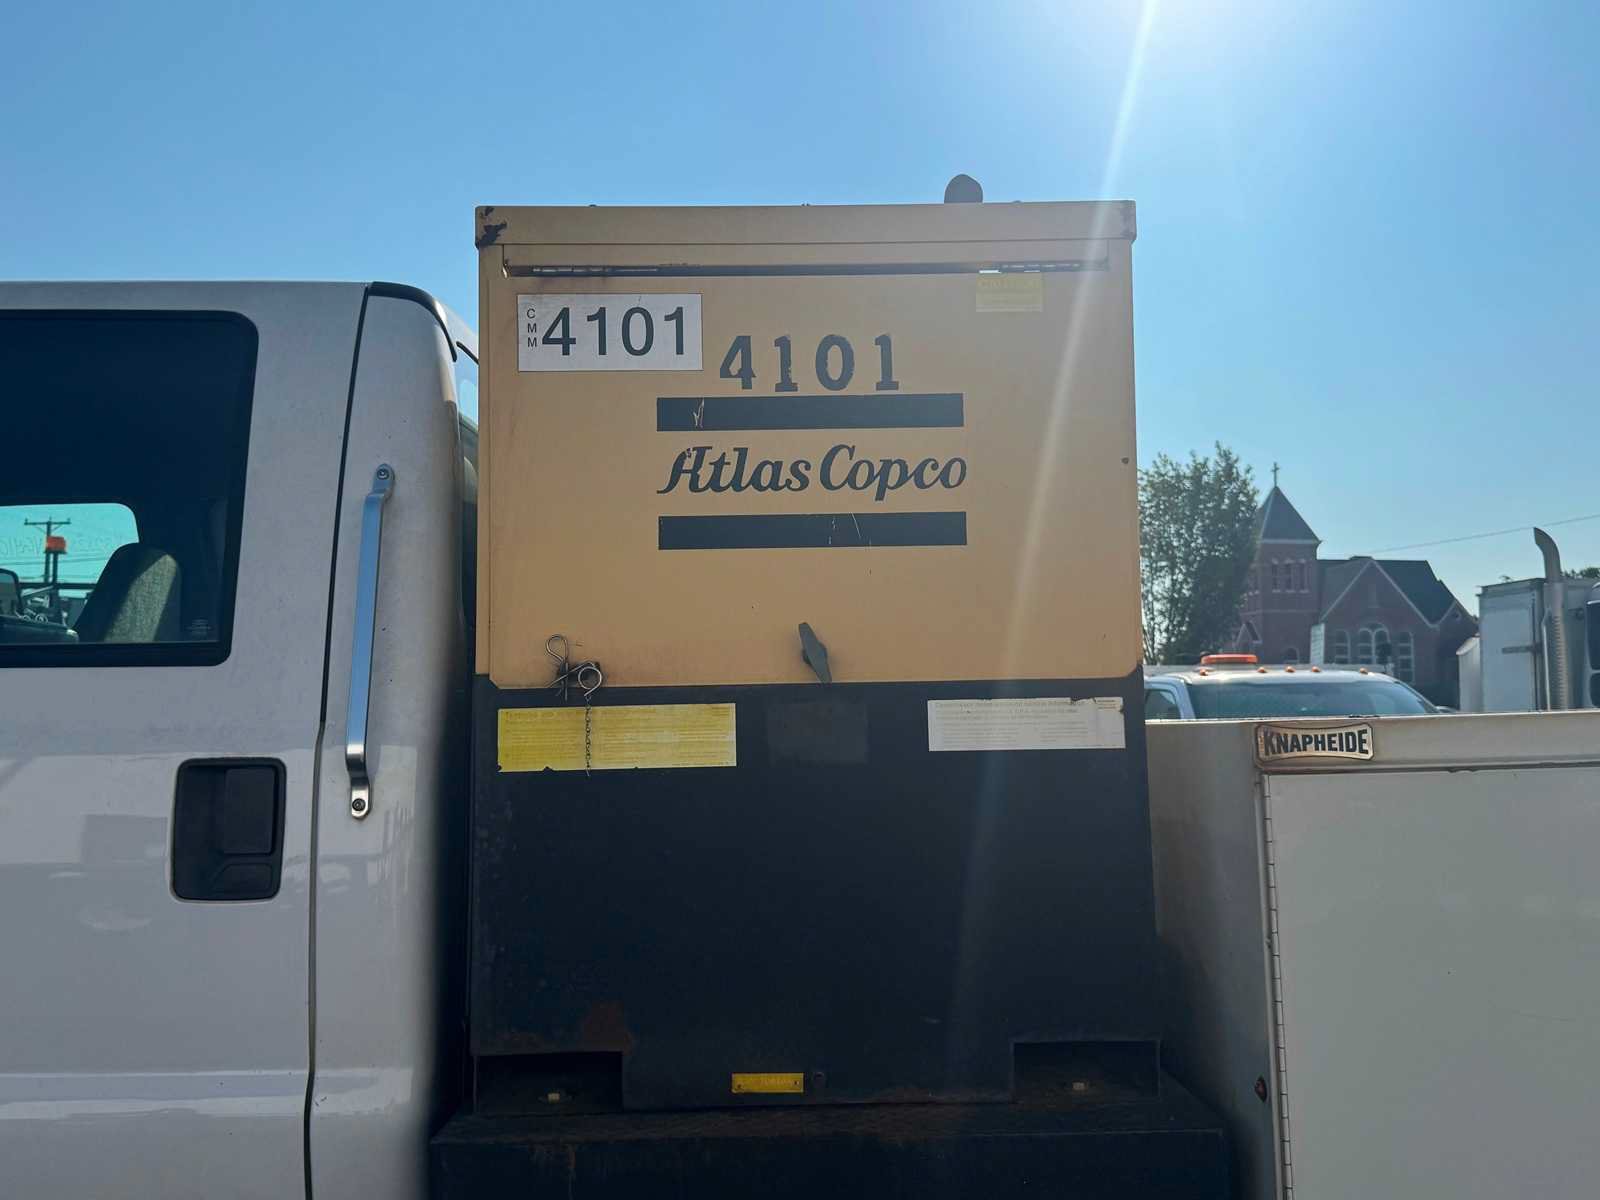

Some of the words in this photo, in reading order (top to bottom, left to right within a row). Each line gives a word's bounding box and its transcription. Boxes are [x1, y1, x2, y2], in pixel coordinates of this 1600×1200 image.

[526, 307, 538, 349] CMM
[541, 306, 685, 357] 4101
[719, 333, 900, 393] 4101
[655, 445, 812, 494] Atlas
[818, 443, 967, 502] Copco
[1263, 728, 1370, 757] KNAPHEIDE
